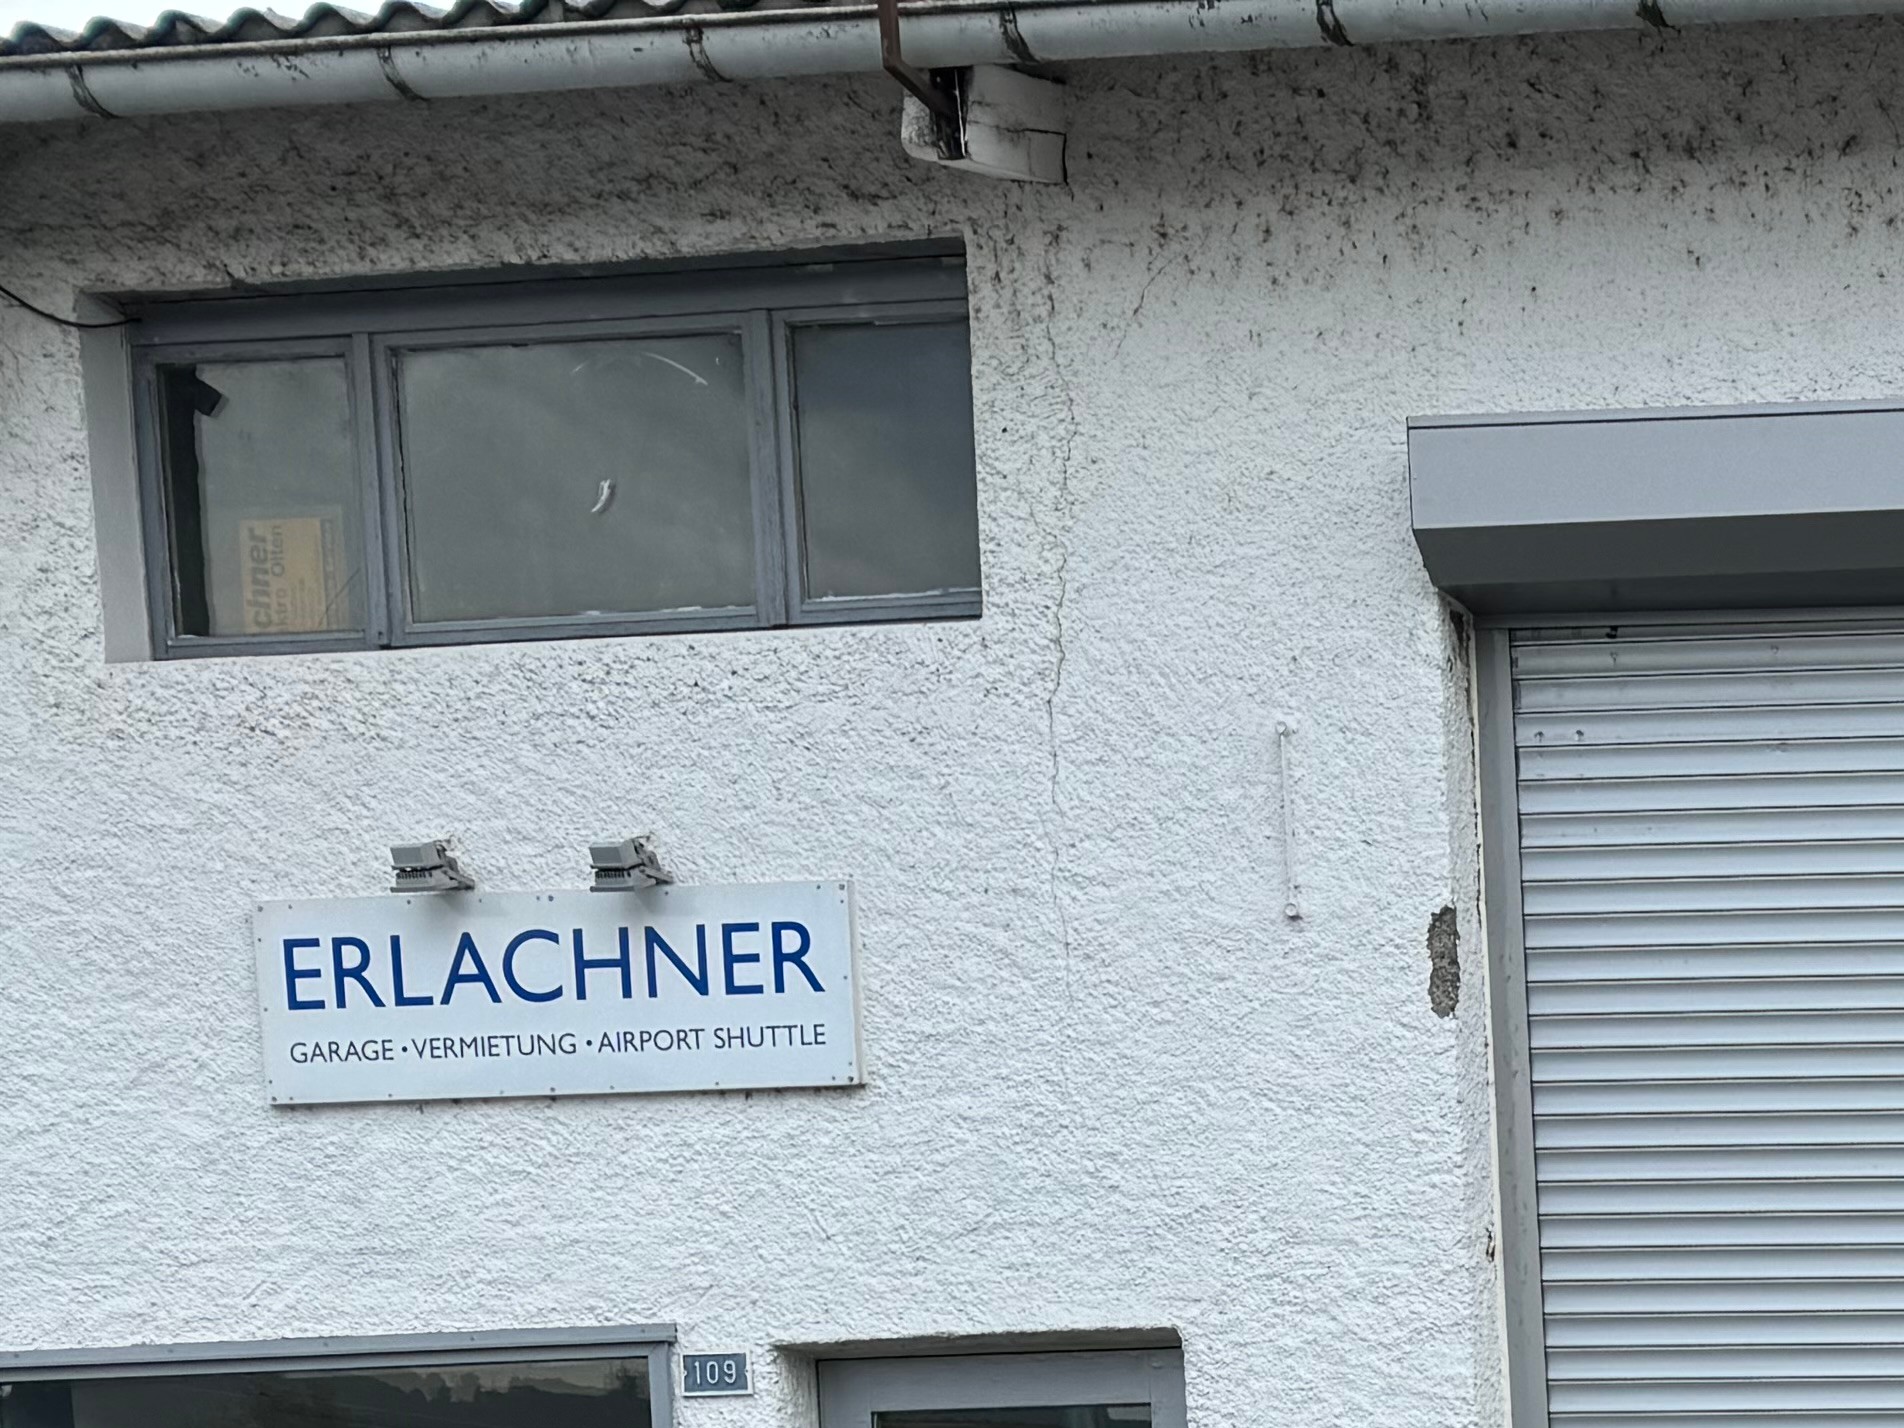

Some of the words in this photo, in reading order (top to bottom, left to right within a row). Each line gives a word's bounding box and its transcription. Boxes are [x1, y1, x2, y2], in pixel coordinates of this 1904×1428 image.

[282, 921, 826, 1011] ERLACHNER
[289, 1038, 395, 1064] GARAGE
[410, 1032, 578, 1060] VERMIETUNG
[597, 1028, 705, 1053] AIRPORT
[713, 1023, 826, 1049] SHUTTLE
[694, 1360, 737, 1385] 109
